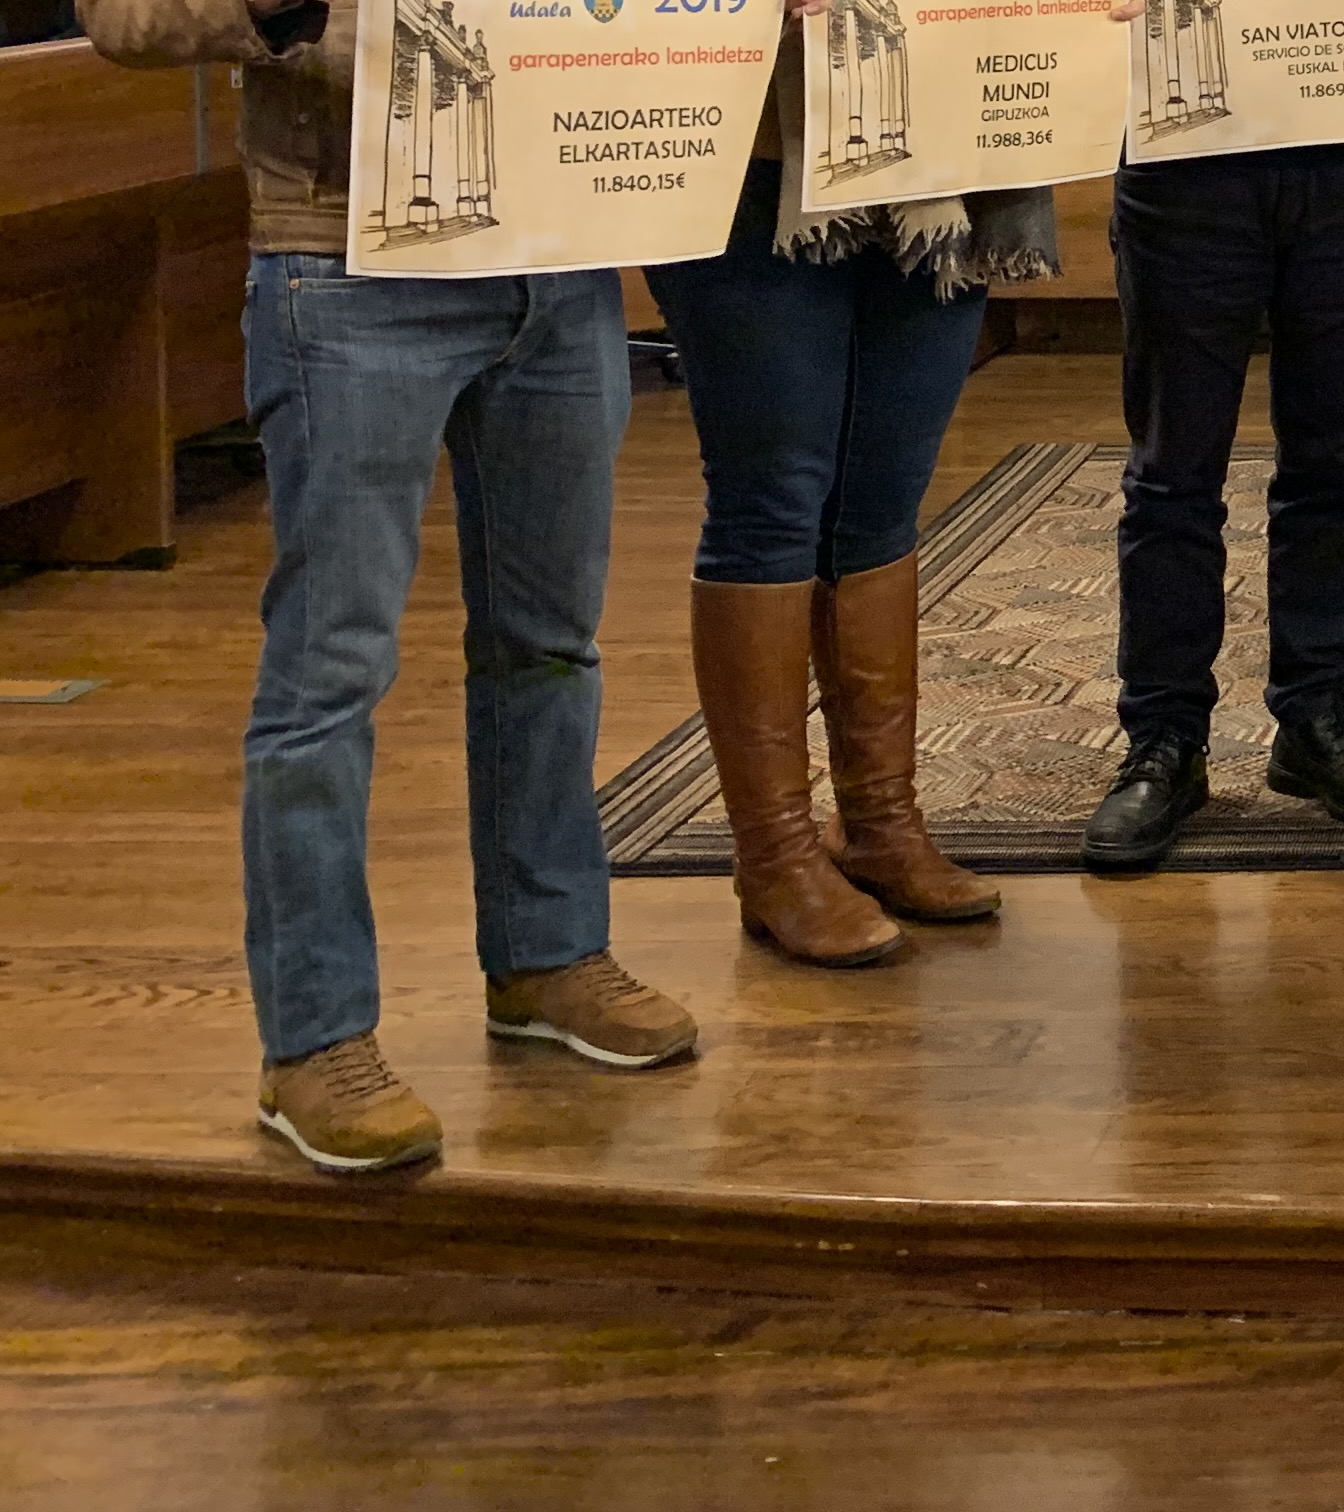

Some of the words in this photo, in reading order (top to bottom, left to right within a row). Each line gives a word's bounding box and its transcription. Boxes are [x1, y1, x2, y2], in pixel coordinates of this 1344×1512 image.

[510, 1, 571, 18] Udala
[916, 1, 1032, 24] garapenerako
[1037, 0, 1112, 16] lankidetza
[1242, 27, 1280, 44] SAN
[509, 47, 660, 71] garapenerako
[666, 45, 764, 66] lankidetza
[976, 52, 1057, 73] MEDICUS
[1253, 47, 1310, 62] SERVICIO
[1314, 44, 1332, 55] DE
[1288, 62, 1338, 76] EUSKAL
[982, 82, 1050, 102] MUNDI
[553, 106, 723, 133] NAZIOARTEKO
[981, 106, 1049, 122] GIPUZKOA
[976, 130, 1053, 148] 11.988,36€
[559, 139, 716, 164] ELKARTASUNA
[593, 172, 685, 194] 11.840,15€
